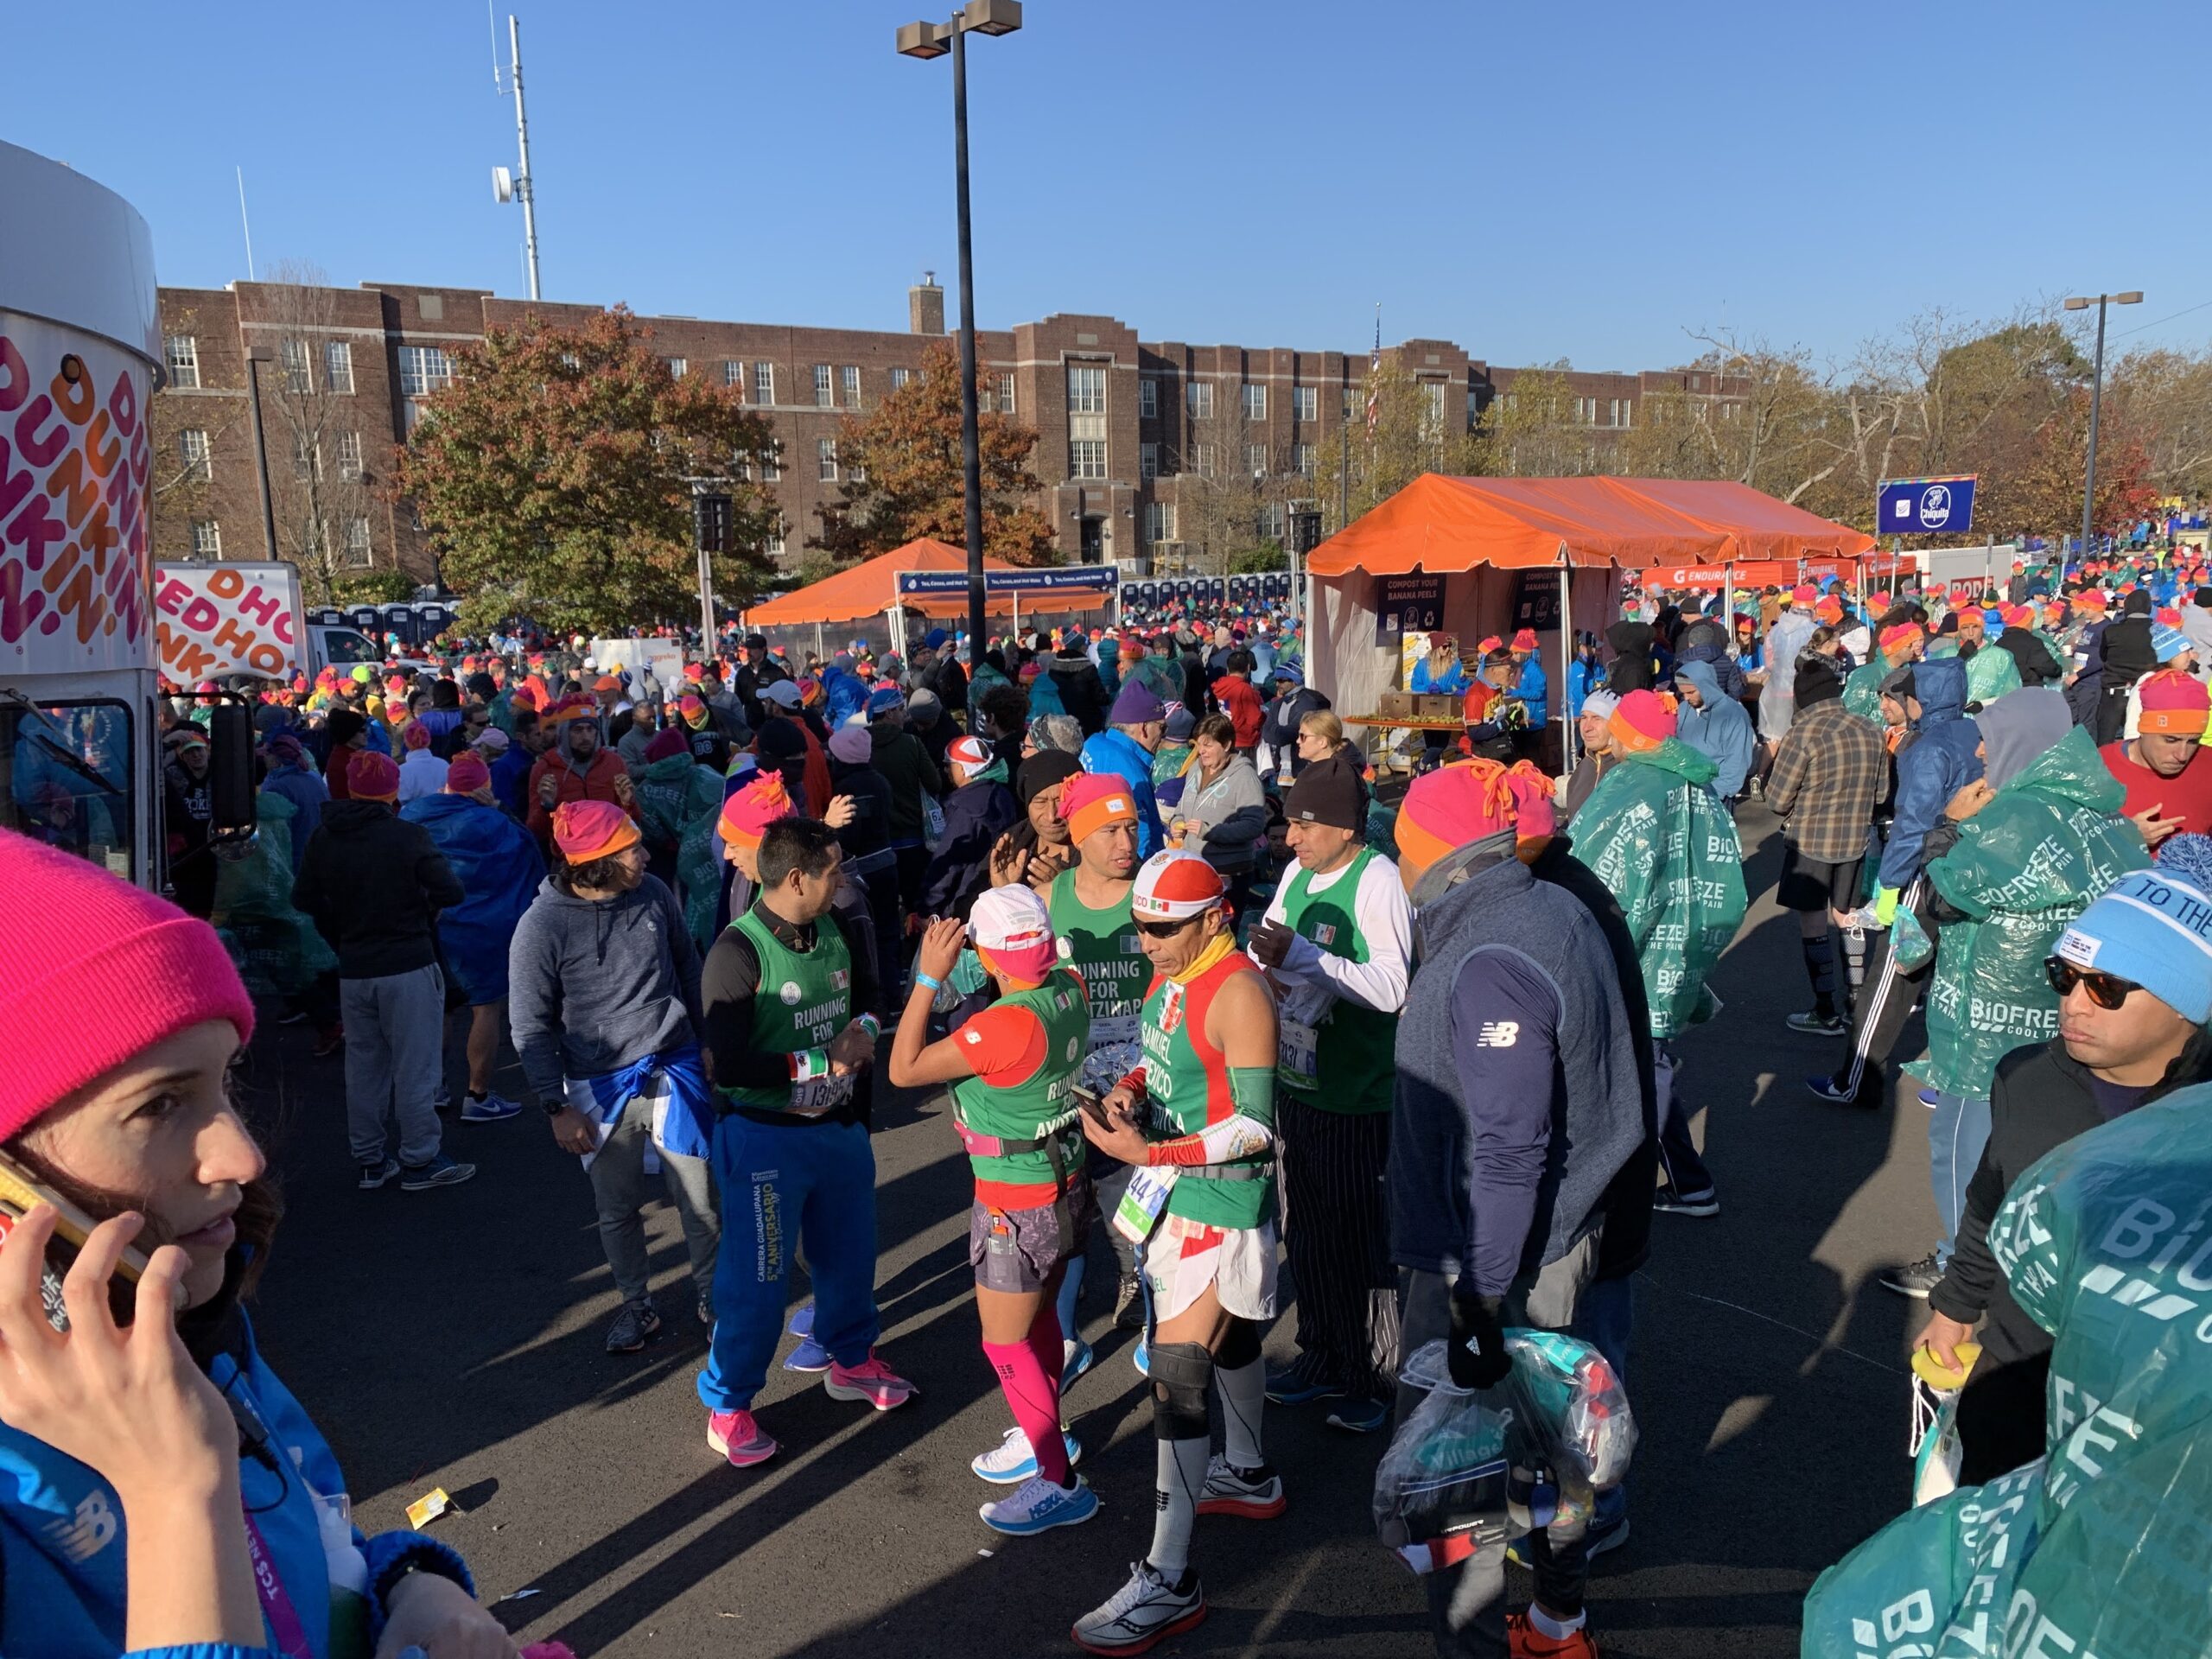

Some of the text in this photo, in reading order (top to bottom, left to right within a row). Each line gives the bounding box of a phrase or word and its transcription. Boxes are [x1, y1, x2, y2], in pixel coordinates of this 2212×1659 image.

[1920, 508, 1949, 522] Chiquita
[1688, 570, 1747, 582] ENDURACE
[1807, 564, 1839, 575] ENDURANCE
[1388, 579, 1439, 589] COMPOST YOUR
[1388, 589, 1437, 601] BANANA PEELS
[2055, 851, 2075, 871] PAIN
[2135, 879, 2172, 906] TO
[1702, 901, 1724, 910] PAIN
[2018, 919, 2052, 932] COOL
[1665, 943, 1683, 951] PAIN
[1089, 981, 1120, 1000] FOR
[794, 995, 847, 1030] RUNNING
[811, 1020, 835, 1045] FOR
[1477, 1021, 1519, 1048] NB
[2006, 1024, 2039, 1039] COOL
[1141, 1020, 1172, 1067] SAMUEL
[753, 1184, 766, 1282] CARRERA GUADALUPANA
[762, 1183, 779, 1265] ANIVERSARIO
[1432, 1443, 1502, 1469] Village
[1028, 1490, 1065, 1521] HOKA
[256, 1560, 279, 1600] TCS
